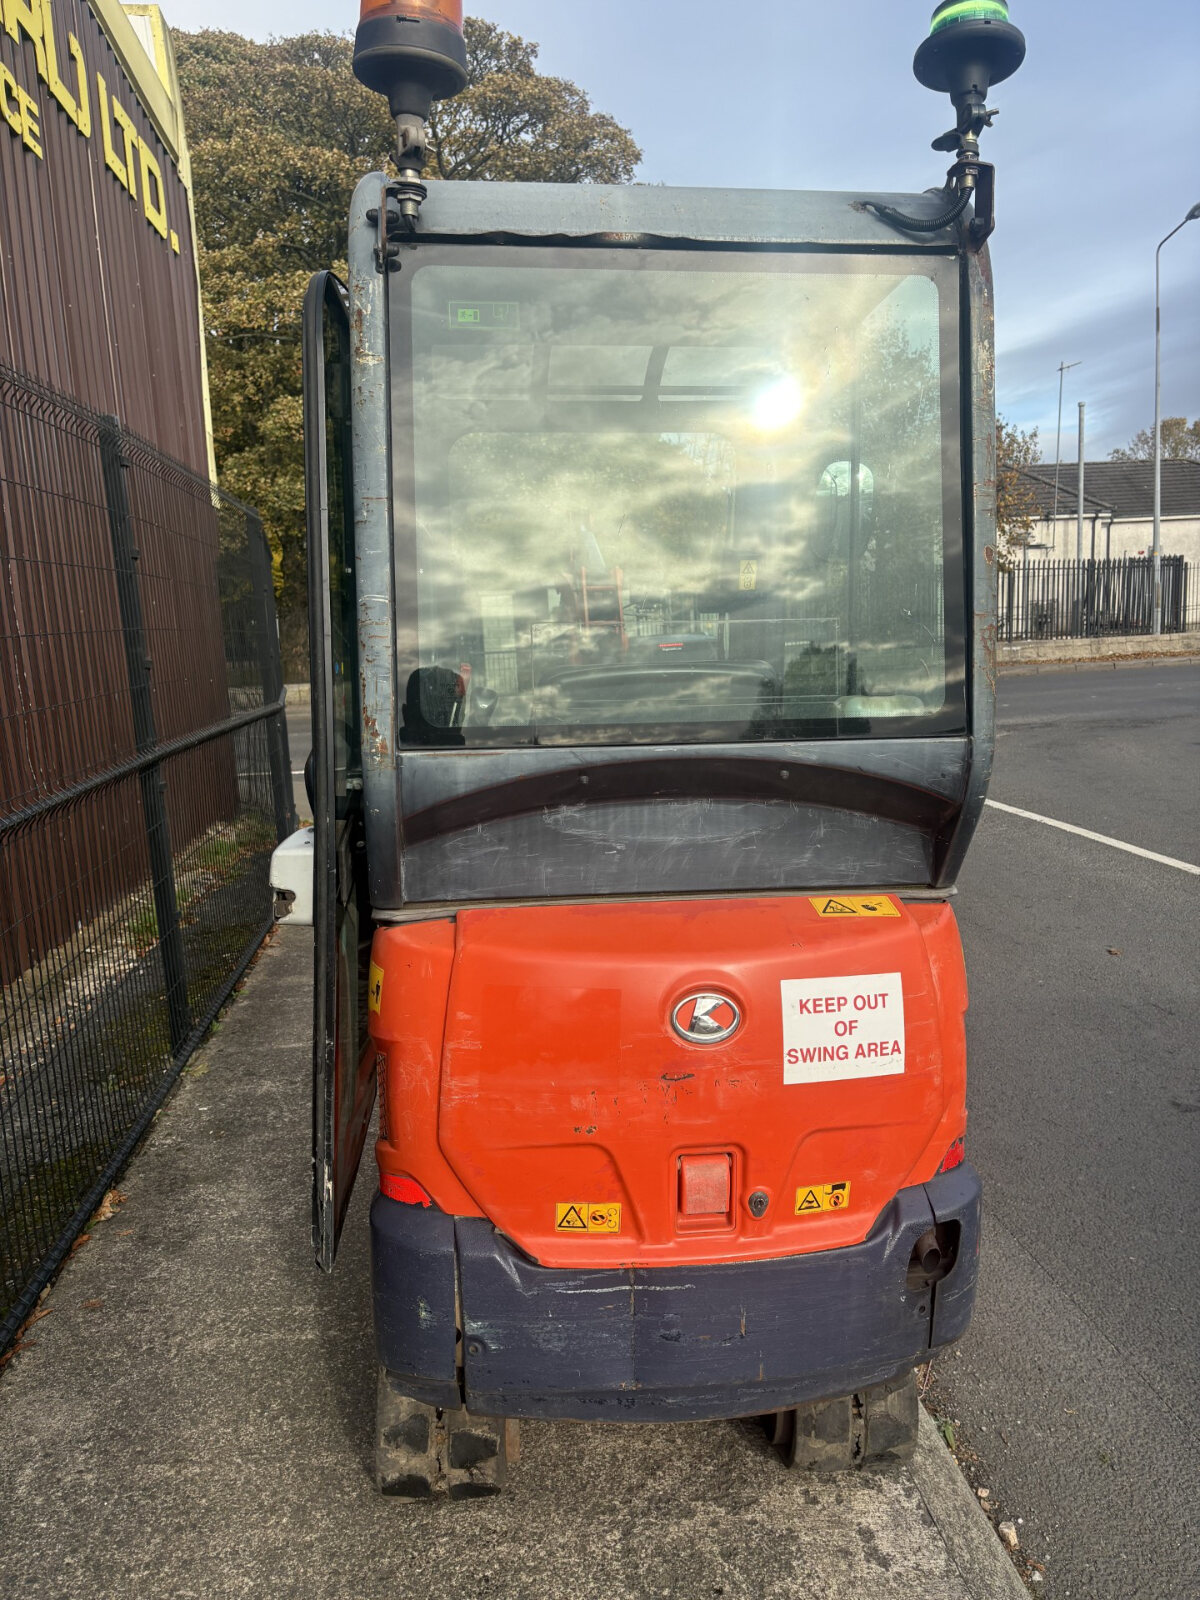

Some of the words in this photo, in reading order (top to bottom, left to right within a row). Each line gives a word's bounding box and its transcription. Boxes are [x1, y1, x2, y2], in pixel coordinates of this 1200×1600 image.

[97, 72, 180, 254] LTD.
[799, 996, 848, 1015] KEEP
[853, 993, 889, 1011] OUT
[834, 1019, 859, 1037] OF
[786, 1044, 849, 1065] SWING
[854, 1040, 902, 1059] AREA
